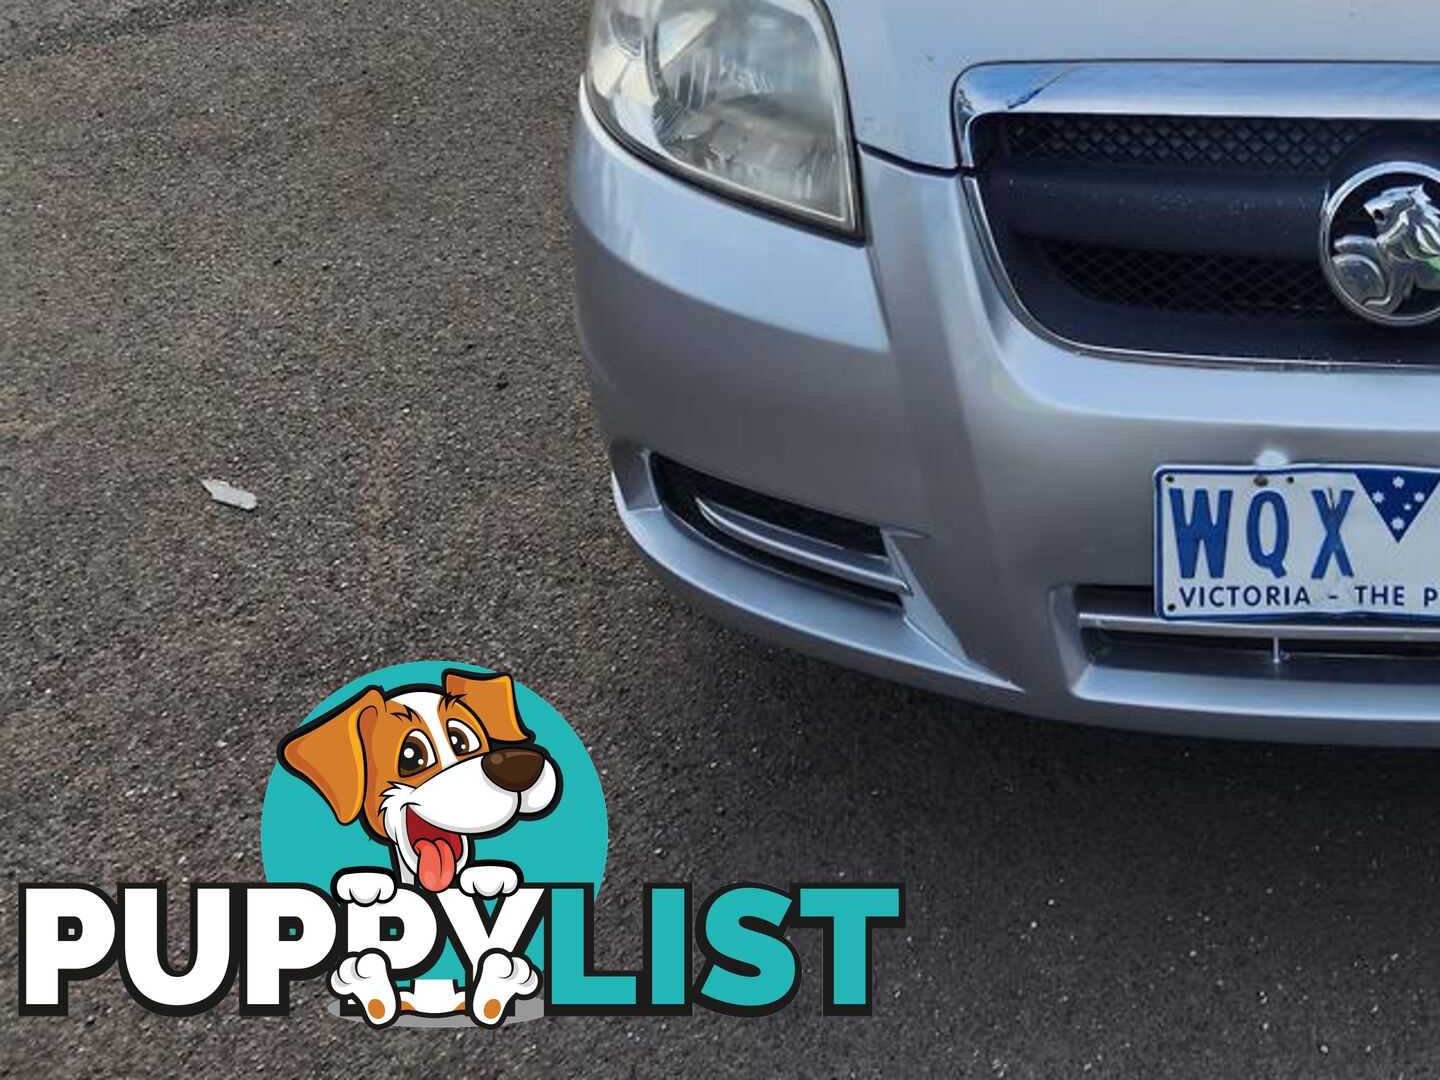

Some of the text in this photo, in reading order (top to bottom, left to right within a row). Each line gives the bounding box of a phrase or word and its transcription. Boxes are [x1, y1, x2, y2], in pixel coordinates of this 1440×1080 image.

[1168, 487, 1355, 581] WQX
[1179, 585, 1310, 607] VICTORIA
[1354, 585, 1406, 606] THE
